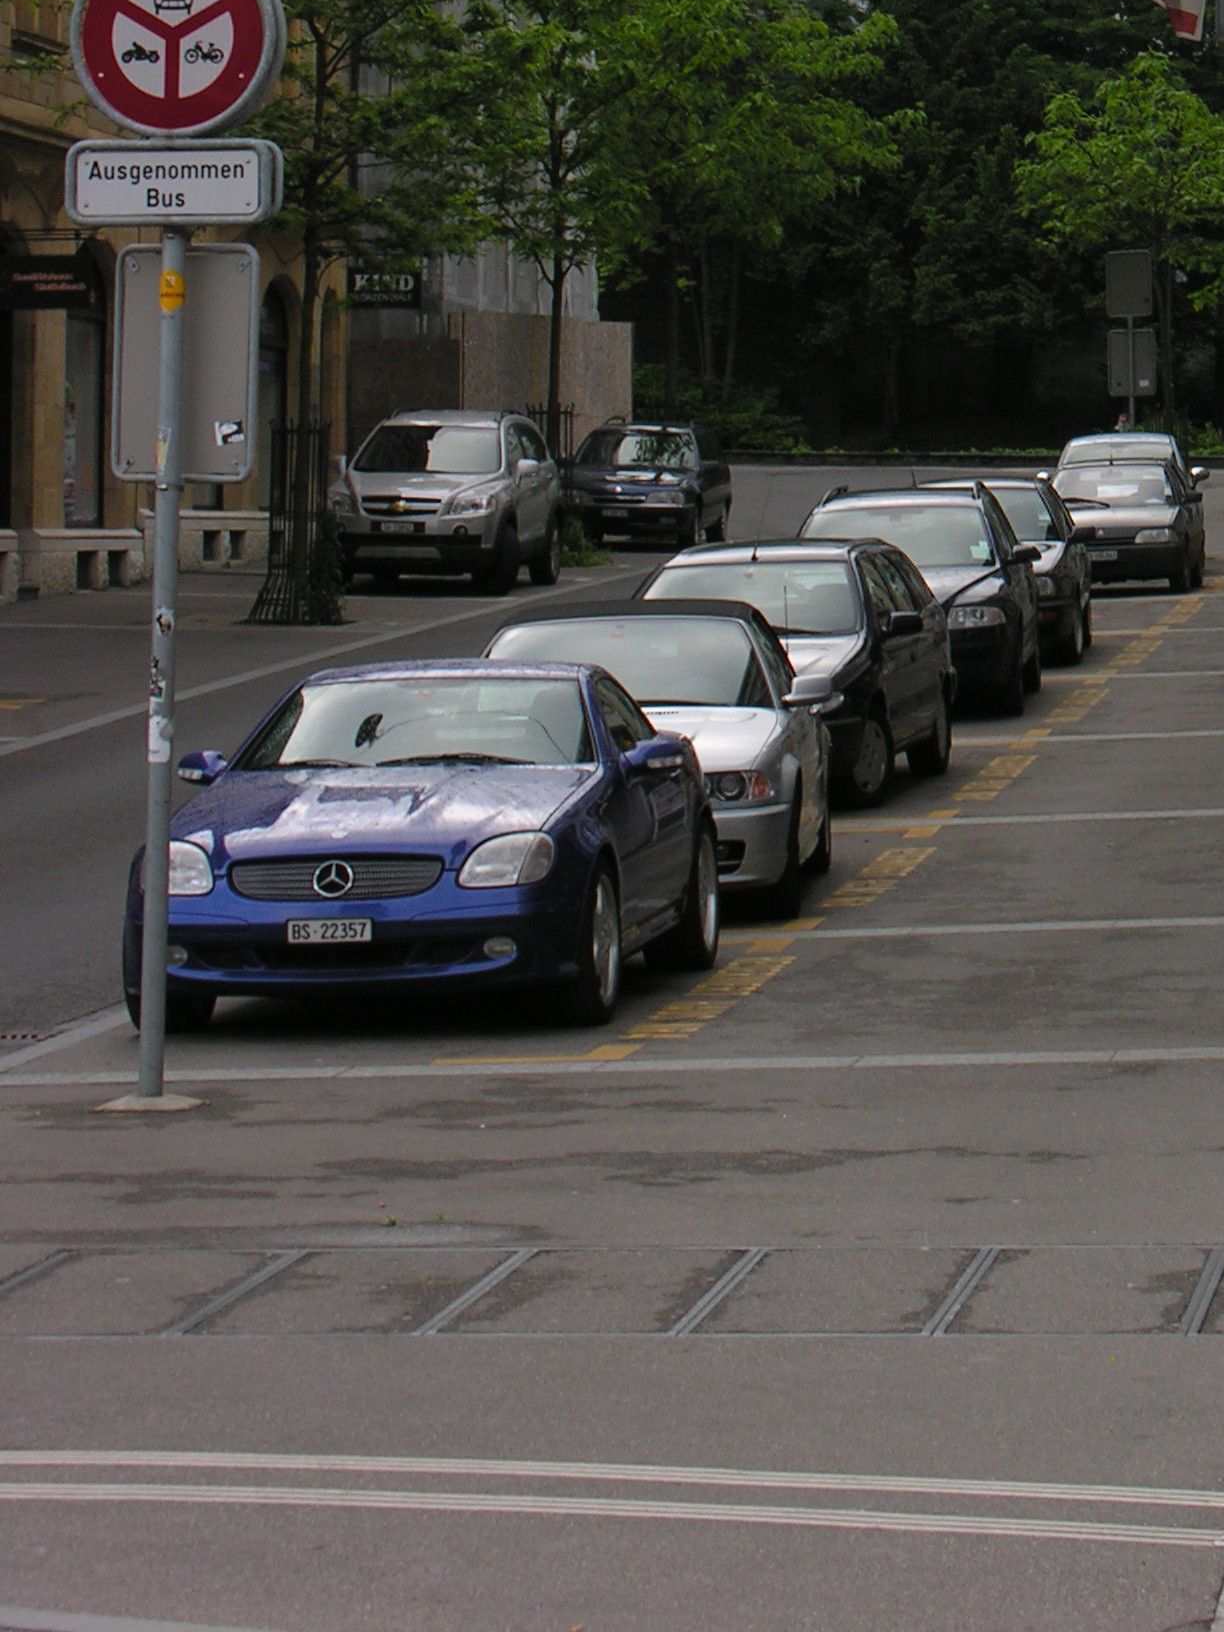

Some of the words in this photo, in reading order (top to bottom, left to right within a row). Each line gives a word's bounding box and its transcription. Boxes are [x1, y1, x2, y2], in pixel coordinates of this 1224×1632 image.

[88, 160, 245, 185] Ausgenommen
[146, 188, 185, 208] Bus
[292, 923, 310, 940] BS
[320, 922, 367, 940] 22357
